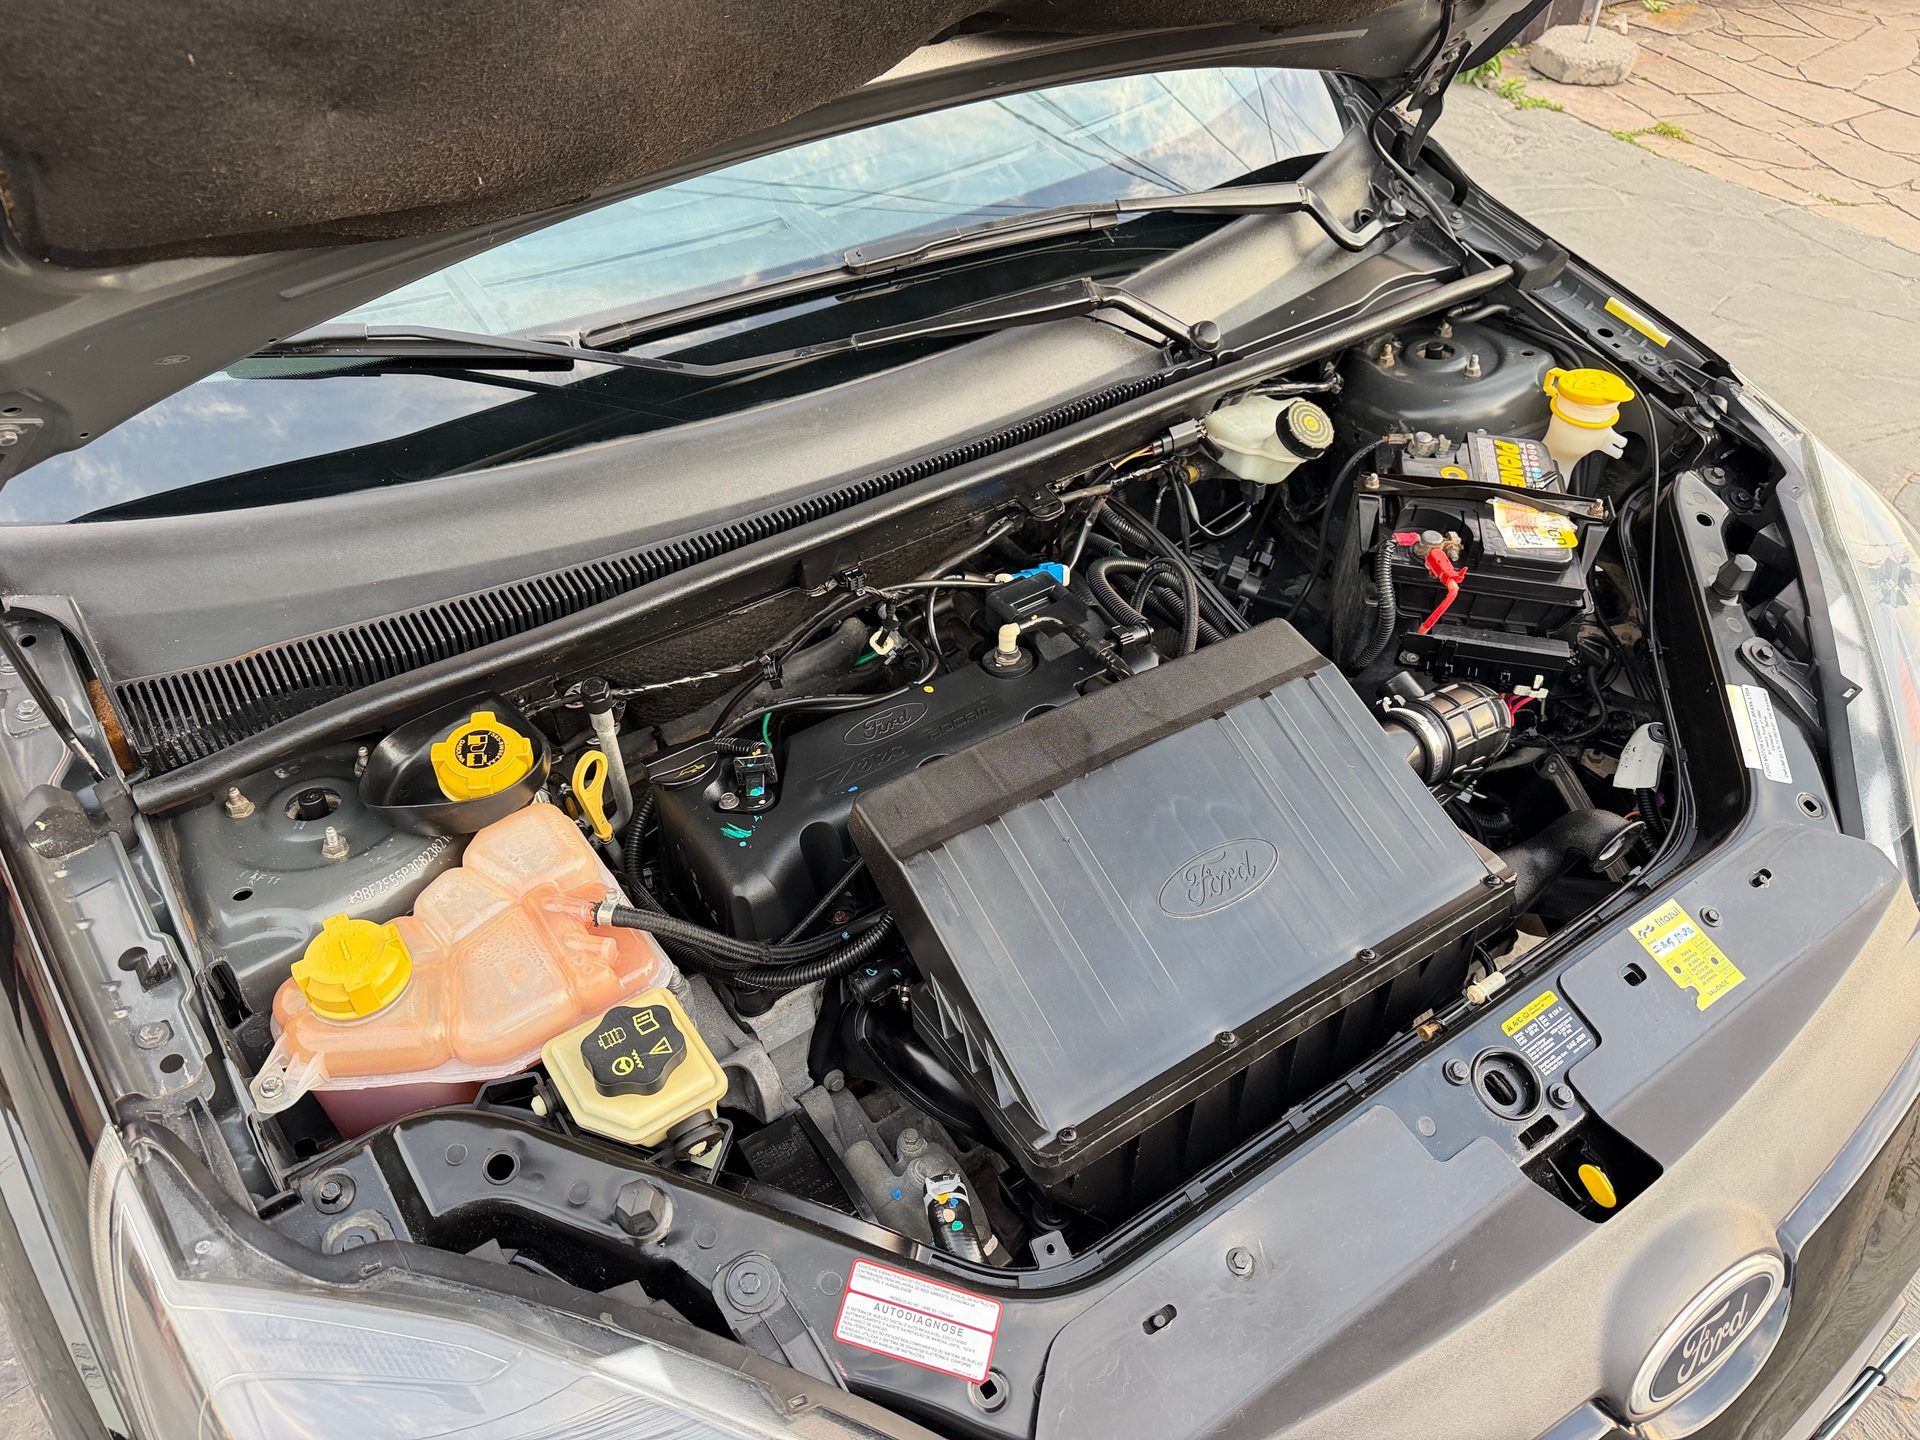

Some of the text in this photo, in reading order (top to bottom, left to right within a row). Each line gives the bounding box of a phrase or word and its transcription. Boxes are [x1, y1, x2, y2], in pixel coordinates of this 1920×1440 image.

[1493, 439, 1526, 488] PIONE
[1747, 701, 1756, 717] BRASIL
[863, 709, 913, 740] Ford
[1752, 719, 1763, 741] COMPANY
[1758, 744, 1768, 760] MOTOR
[1763, 763, 1772, 776] FORD
[1185, 849, 1257, 907] Ford
[1653, 905, 1680, 927] fitazul
[1706, 978, 1729, 997] VALIDADE
[1511, 1016, 1523, 1027] A/C
[873, 1302, 965, 1337] AUTODIAGNOSE
[1676, 1292, 1750, 1385] Ford
